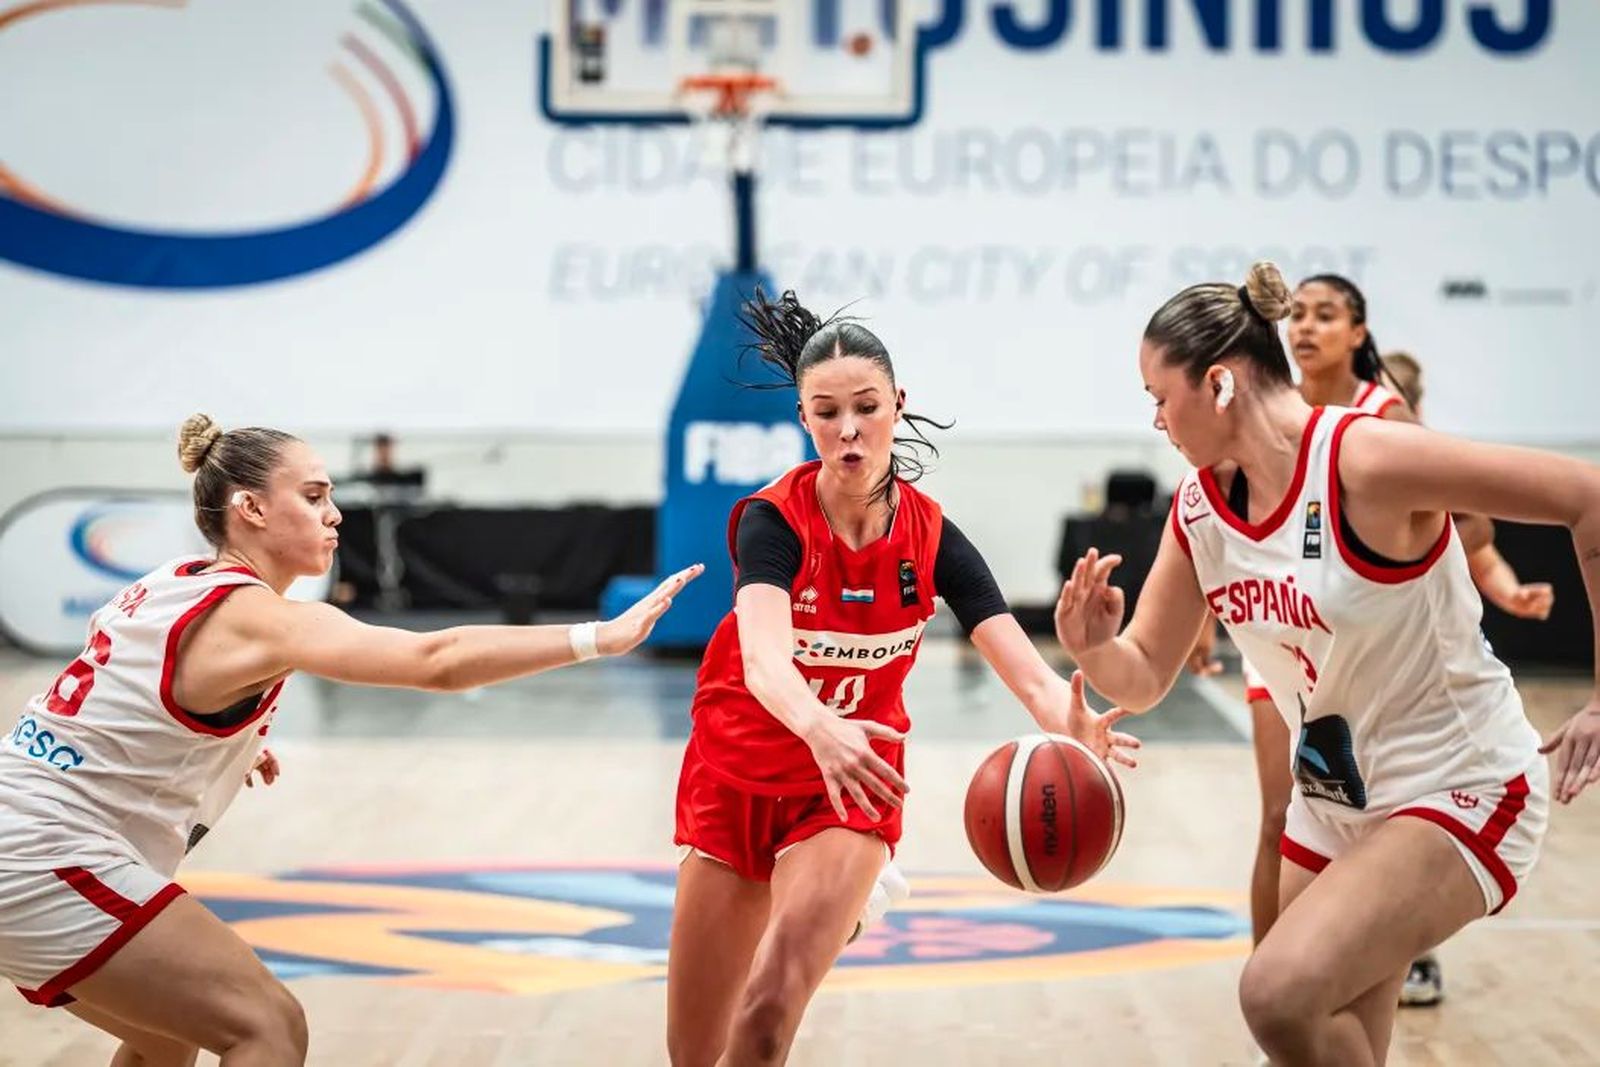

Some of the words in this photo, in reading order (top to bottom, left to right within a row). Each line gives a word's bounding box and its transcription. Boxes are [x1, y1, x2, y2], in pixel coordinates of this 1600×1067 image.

[850, 127, 1230, 196] EUROPEIA
[1254, 128, 1361, 198] DO
[904, 243, 1057, 305] CITY
[1064, 243, 1152, 305] OF
[1206, 575, 1334, 635] ESPAÑA
